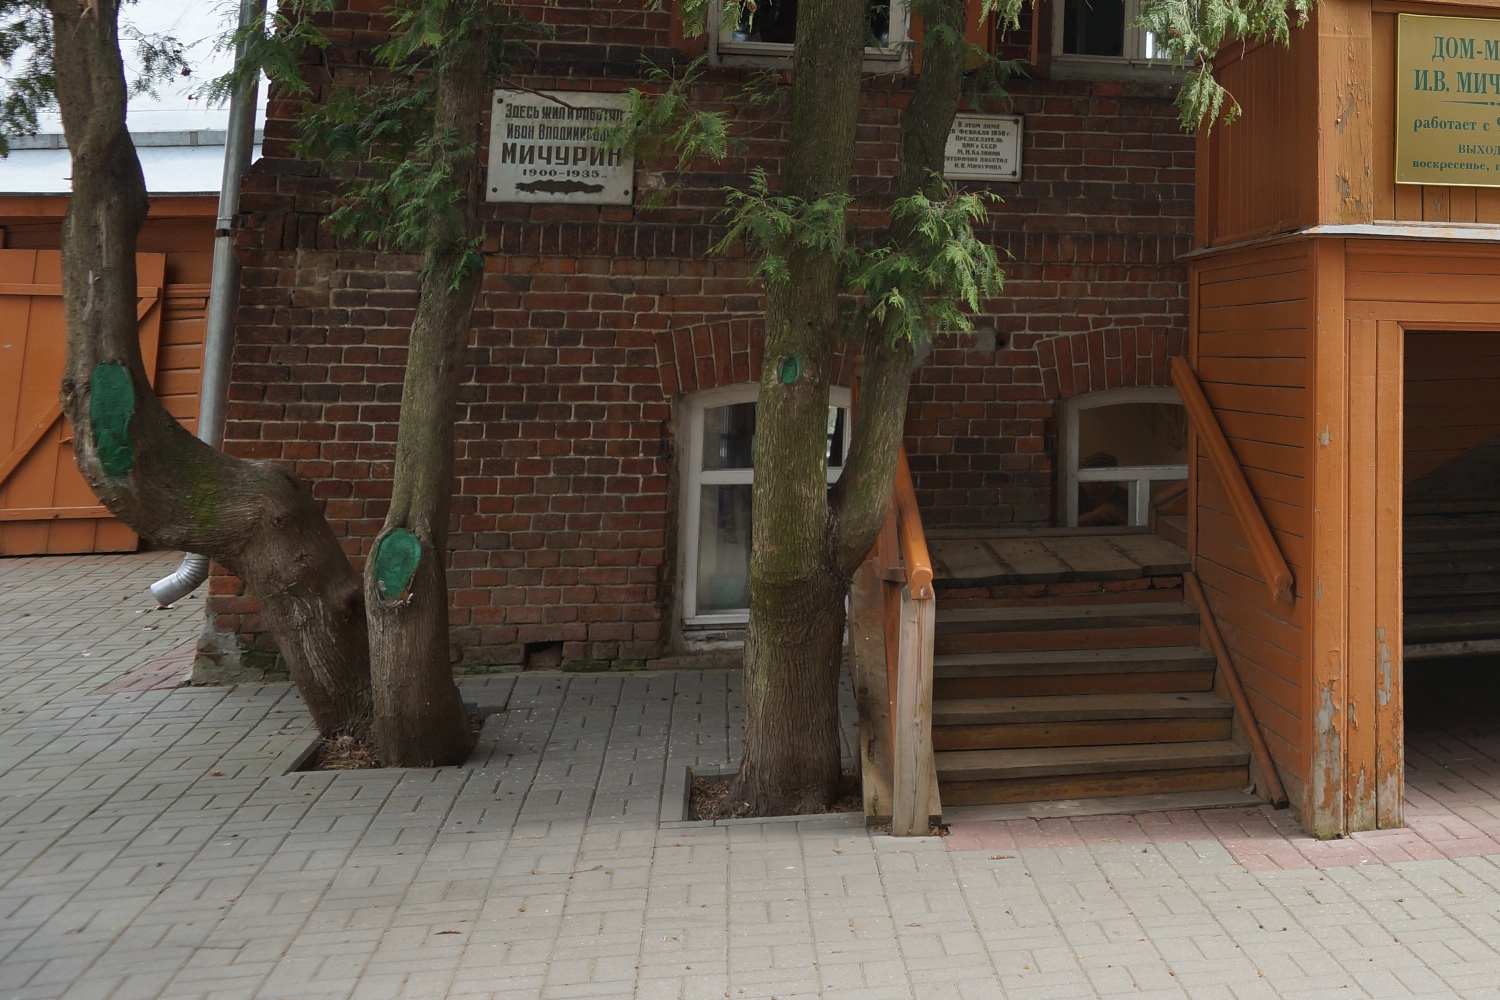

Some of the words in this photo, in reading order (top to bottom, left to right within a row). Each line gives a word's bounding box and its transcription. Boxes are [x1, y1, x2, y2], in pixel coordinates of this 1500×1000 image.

[1414, 69, 1449, 92] И.В.
[542, 106, 565, 119] ЖИЛ
[568, 107, 573, 119] И
[1413, 116, 1476, 132] работает
[1483, 122, 1490, 131] с
[502, 143, 621, 166] МИЧУРИН
[1412, 160, 1490, 171] воскресенье,
[523, 169, 599, 178] 1900-1935
